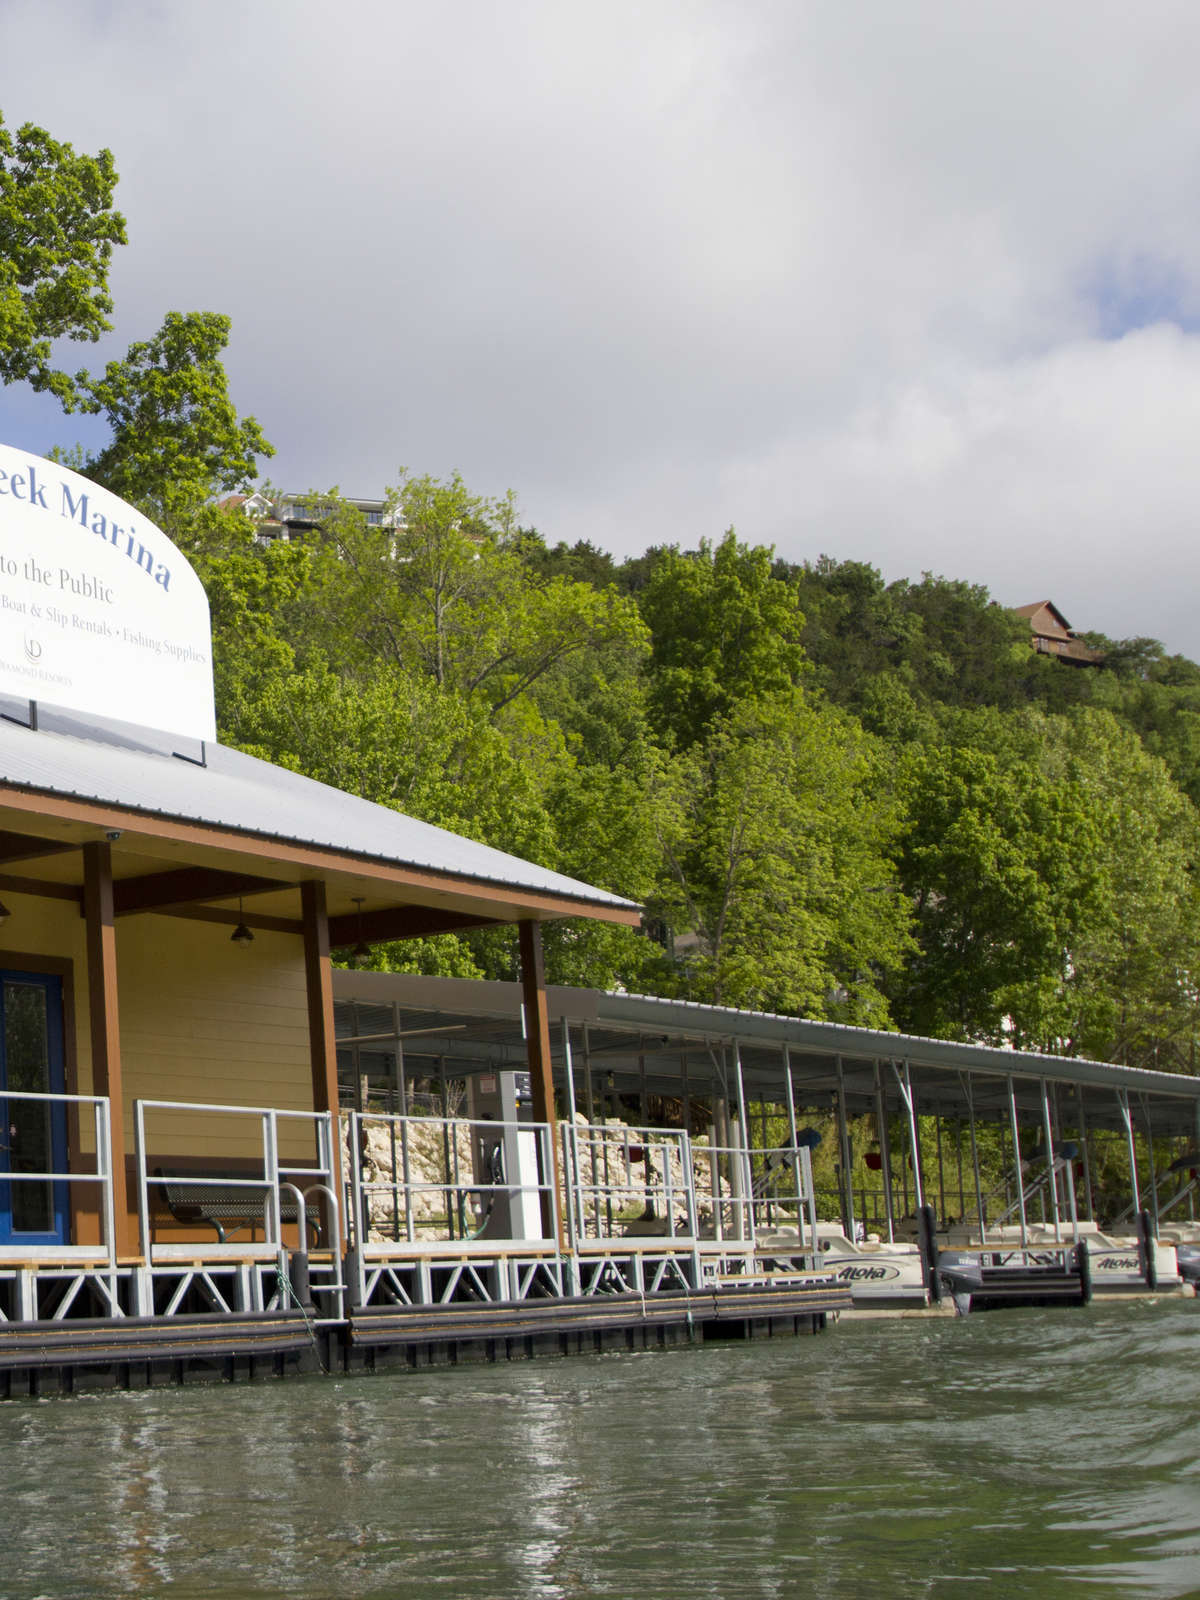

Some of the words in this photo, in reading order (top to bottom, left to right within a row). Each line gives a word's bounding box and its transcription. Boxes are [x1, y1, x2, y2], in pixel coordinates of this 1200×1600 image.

[59, 481, 172, 592] Marina
[0, 554, 18, 577] to
[24, 558, 53, 586] the
[59, 568, 115, 605] Public
[1, 594, 27, 615] Boat
[30, 602, 43, 618] &
[45, 606, 69, 628] Slip
[71, 613, 113, 637] Rentals
[122, 627, 162, 655] Fishing
[163, 639, 207, 664] Supplies
